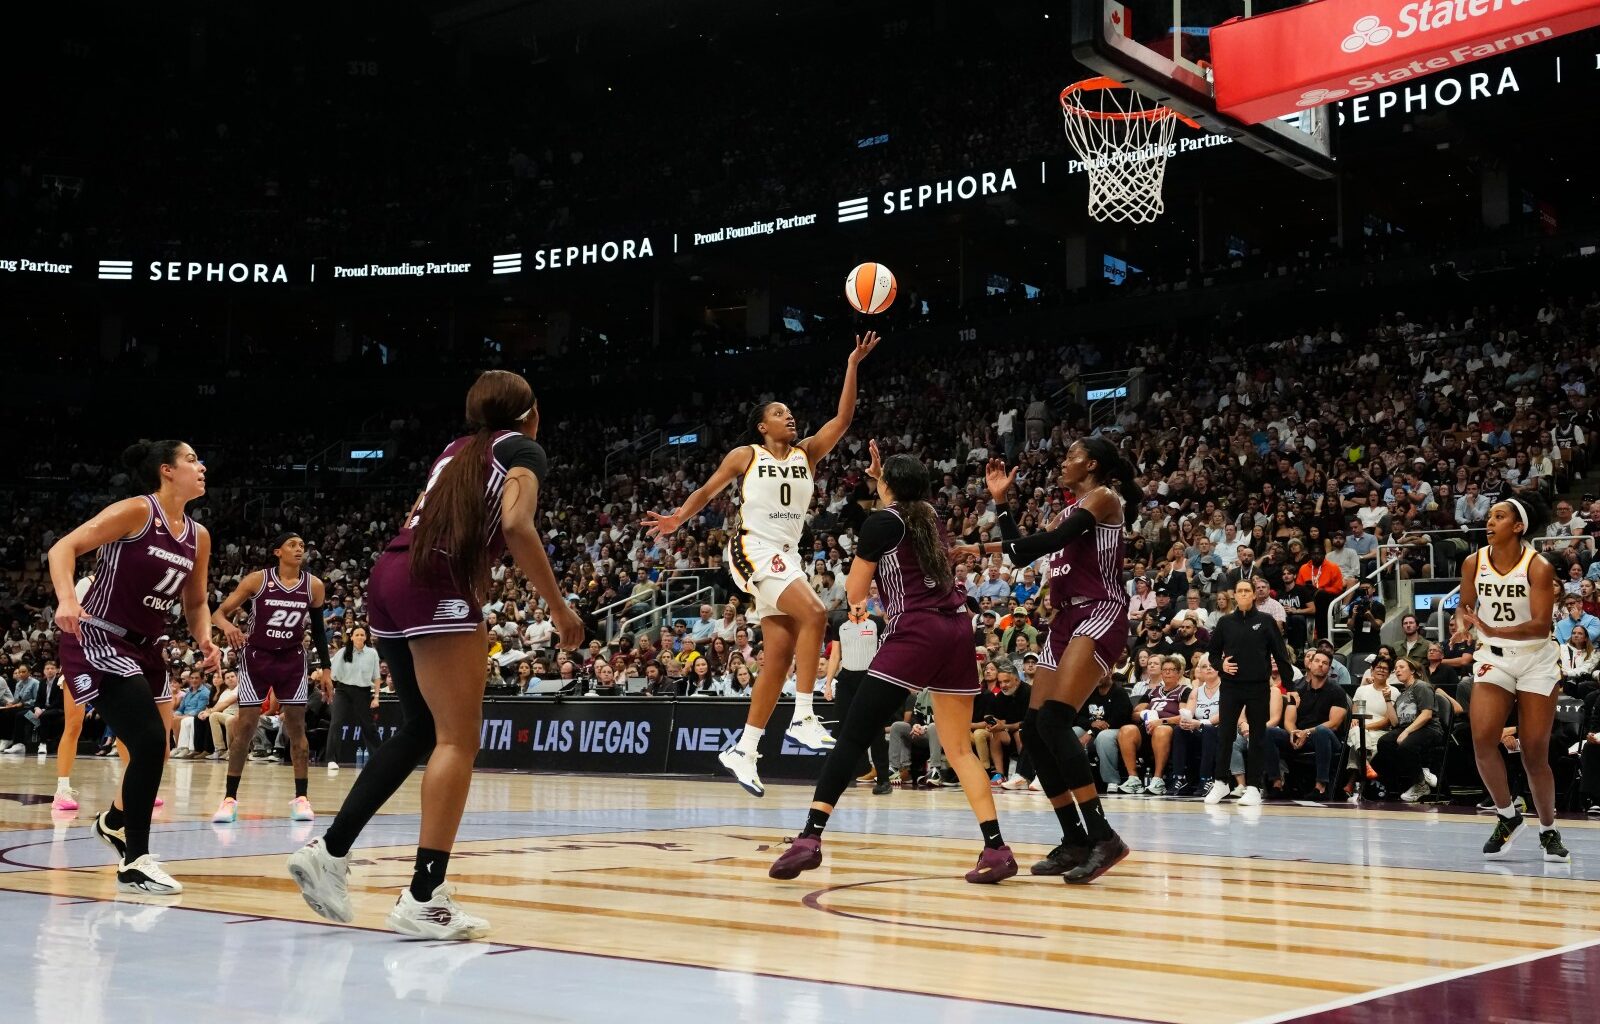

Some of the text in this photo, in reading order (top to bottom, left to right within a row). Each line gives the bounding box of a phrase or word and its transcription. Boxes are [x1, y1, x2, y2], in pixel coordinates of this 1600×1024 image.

[1180, 133, 1234, 152] Partner
[883, 168, 1017, 214] SEPHORA
[694, 213, 817, 245] Proud Founding Partner
[535, 237, 654, 270] SEPHORA
[20, 258, 73, 274] Partner
[149, 261, 288, 283] SEPHORA
[333, 262, 471, 278] Proud Founding Partner
[959, 328, 977, 340] 118
[1092, 390, 1122, 398] SEPHA
[758, 465, 809, 480] FEVER
[780, 482, 791, 506] 0
[152, 567, 187, 596] 11
[1478, 583, 1527, 598] FEVER
[264, 599, 307, 609] TORONTO
[1491, 602, 1516, 622] 25
[266, 609, 302, 628] 20
[1202, 709, 1210, 720] 3
[532, 719, 575, 753] LAS
[579, 720, 651, 755] VEGAS
[676, 727, 765, 751] NEX
